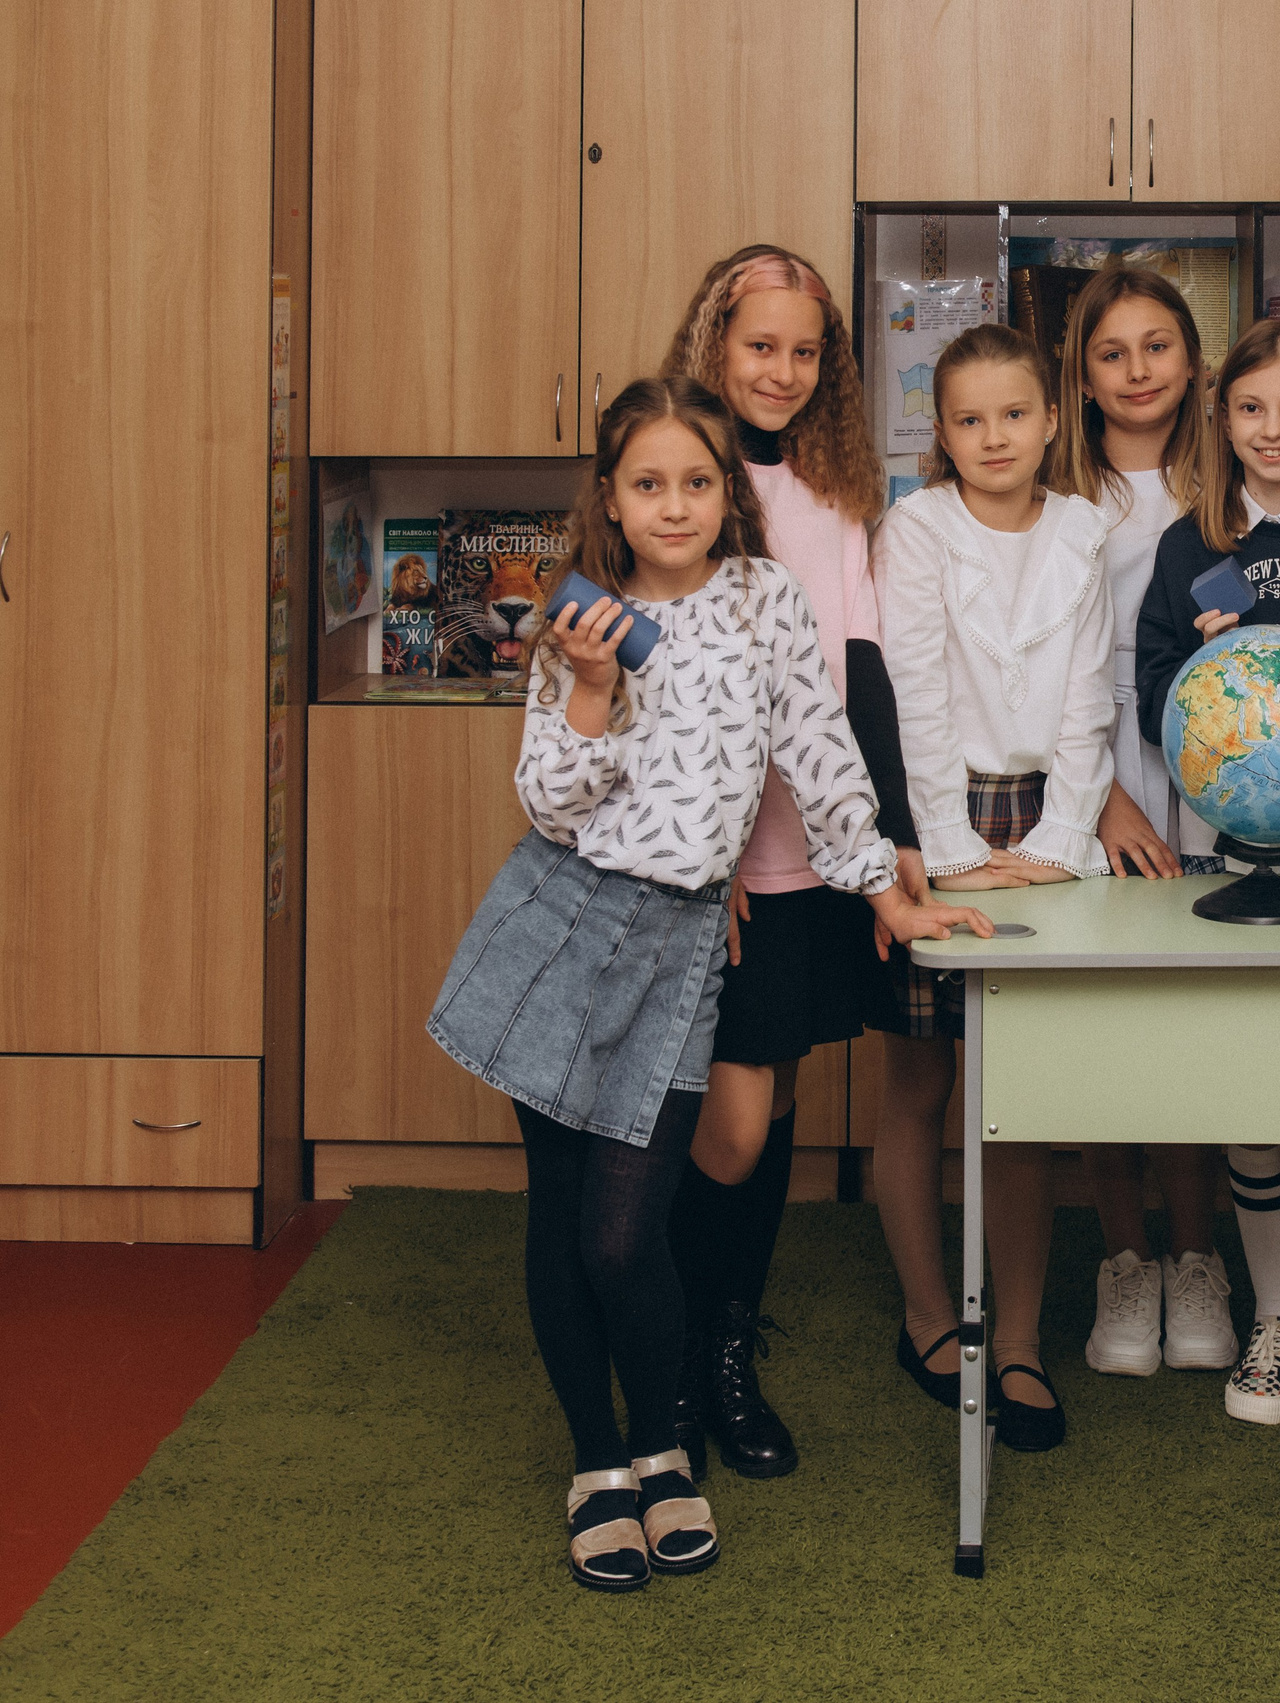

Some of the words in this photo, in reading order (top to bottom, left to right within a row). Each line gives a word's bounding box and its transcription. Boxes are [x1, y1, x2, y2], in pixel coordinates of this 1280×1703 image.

[489, 524, 543, 534] ТВАРИНИ-
[1243, 558, 1273, 582] NEW
[389, 610, 421, 625] ХТО
